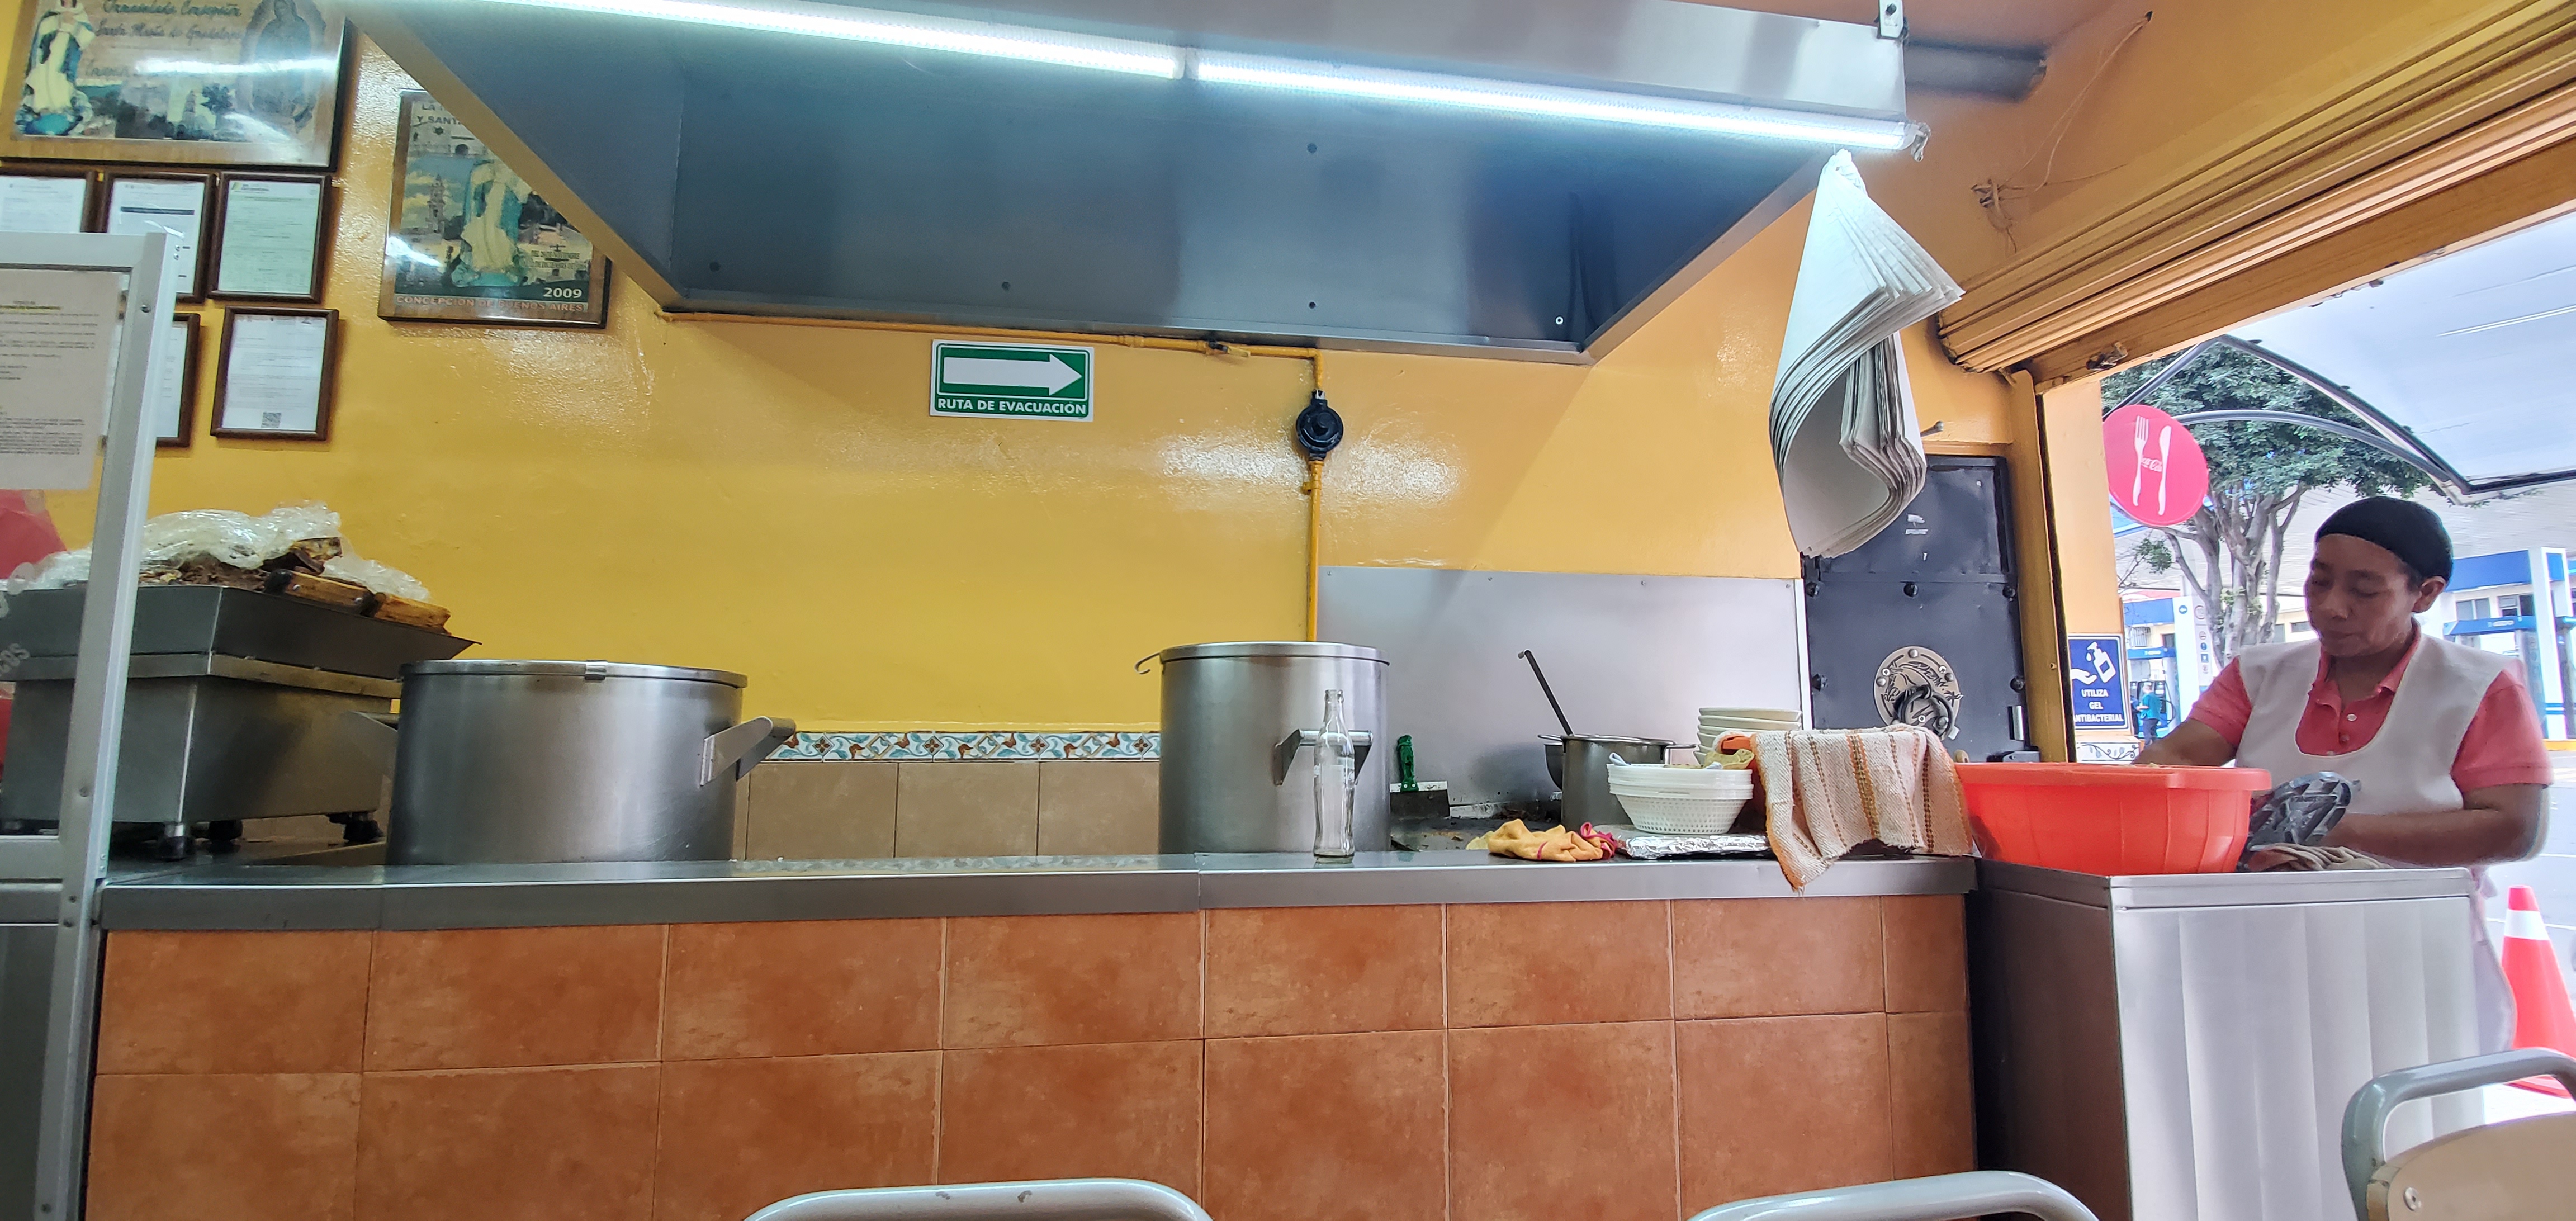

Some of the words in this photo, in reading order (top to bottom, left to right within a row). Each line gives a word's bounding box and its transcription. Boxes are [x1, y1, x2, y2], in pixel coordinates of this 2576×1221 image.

[543, 287, 583, 299] 2009
[396, 296, 475, 307] CONCEPCION
[498, 300, 546, 310] BUENOS
[549, 303, 583, 312] AIRES
[937, 398, 973, 410] RUTA
[977, 400, 995, 411] DE
[998, 401, 1087, 414] EVACUACIÓN
[2081, 689, 2109, 697] UTILIZA
[2089, 701, 2104, 710] GEL
